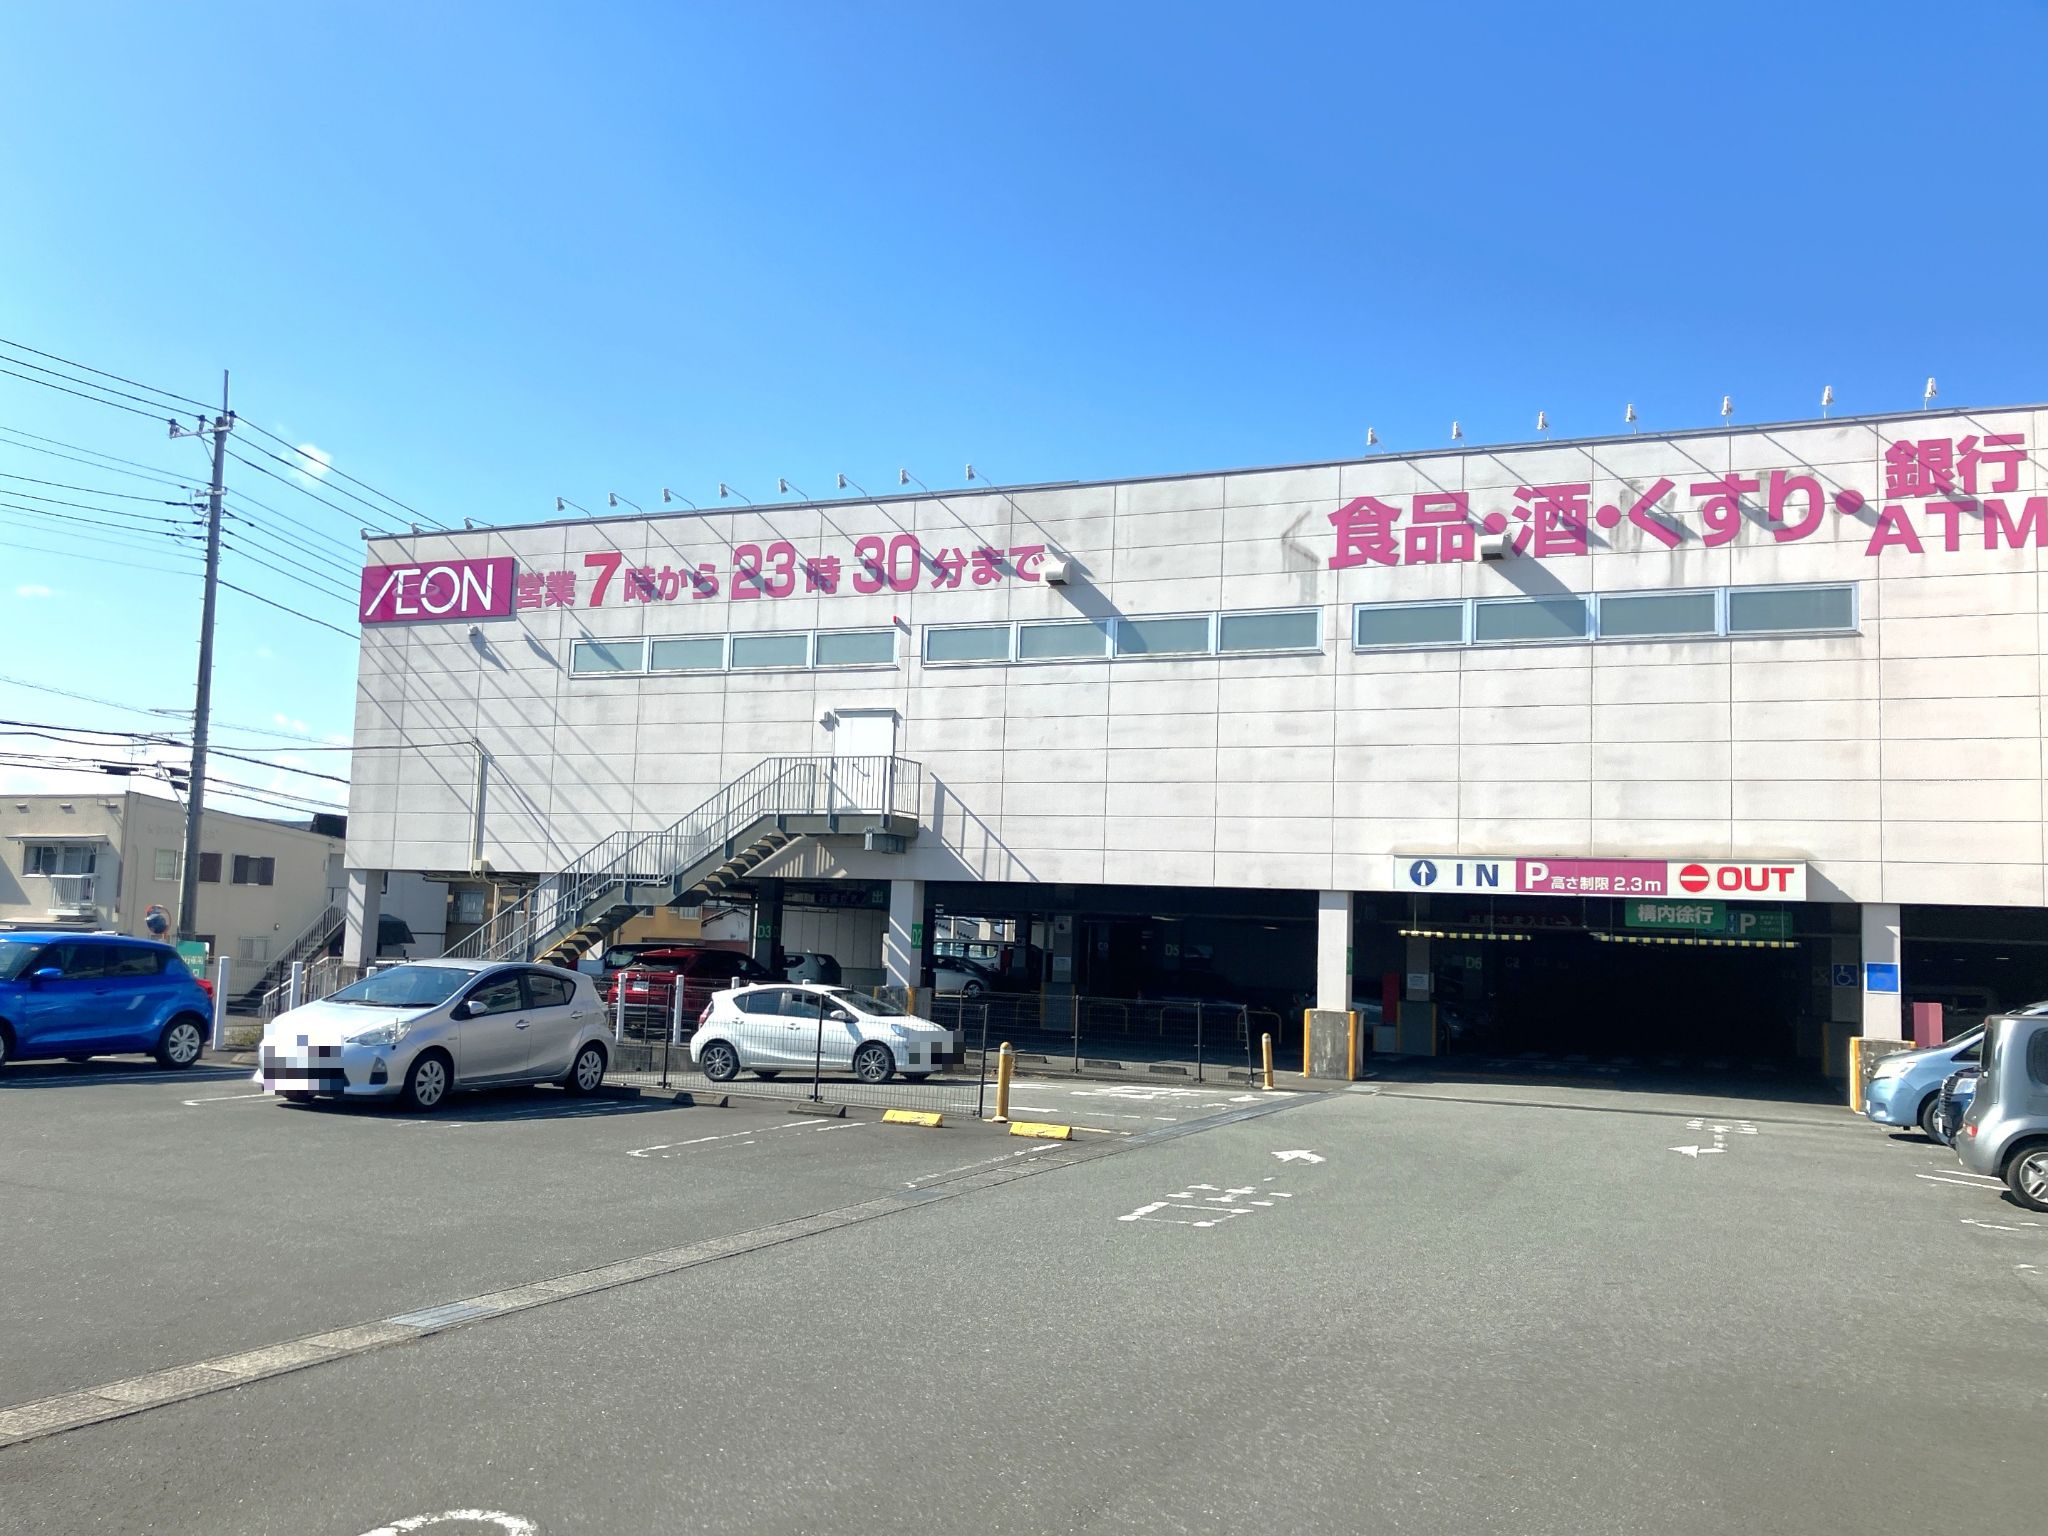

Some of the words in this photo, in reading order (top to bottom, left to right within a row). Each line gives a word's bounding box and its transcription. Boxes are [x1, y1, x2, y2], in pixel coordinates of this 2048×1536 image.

[1885, 433, 2028, 499] 銀行
[1865, 496, 2048, 556] ATM
[1456, 863, 1499, 887] IN
[1524, 862, 1550, 889] P
[1551, 876, 1610, 891] 高さ制限
[1613, 877, 1662, 893] 2.3m
[1717, 867, 1795, 892] OUT
[1637, 904, 1714, 925] 構内徐行
[1740, 913, 1756, 934] P
